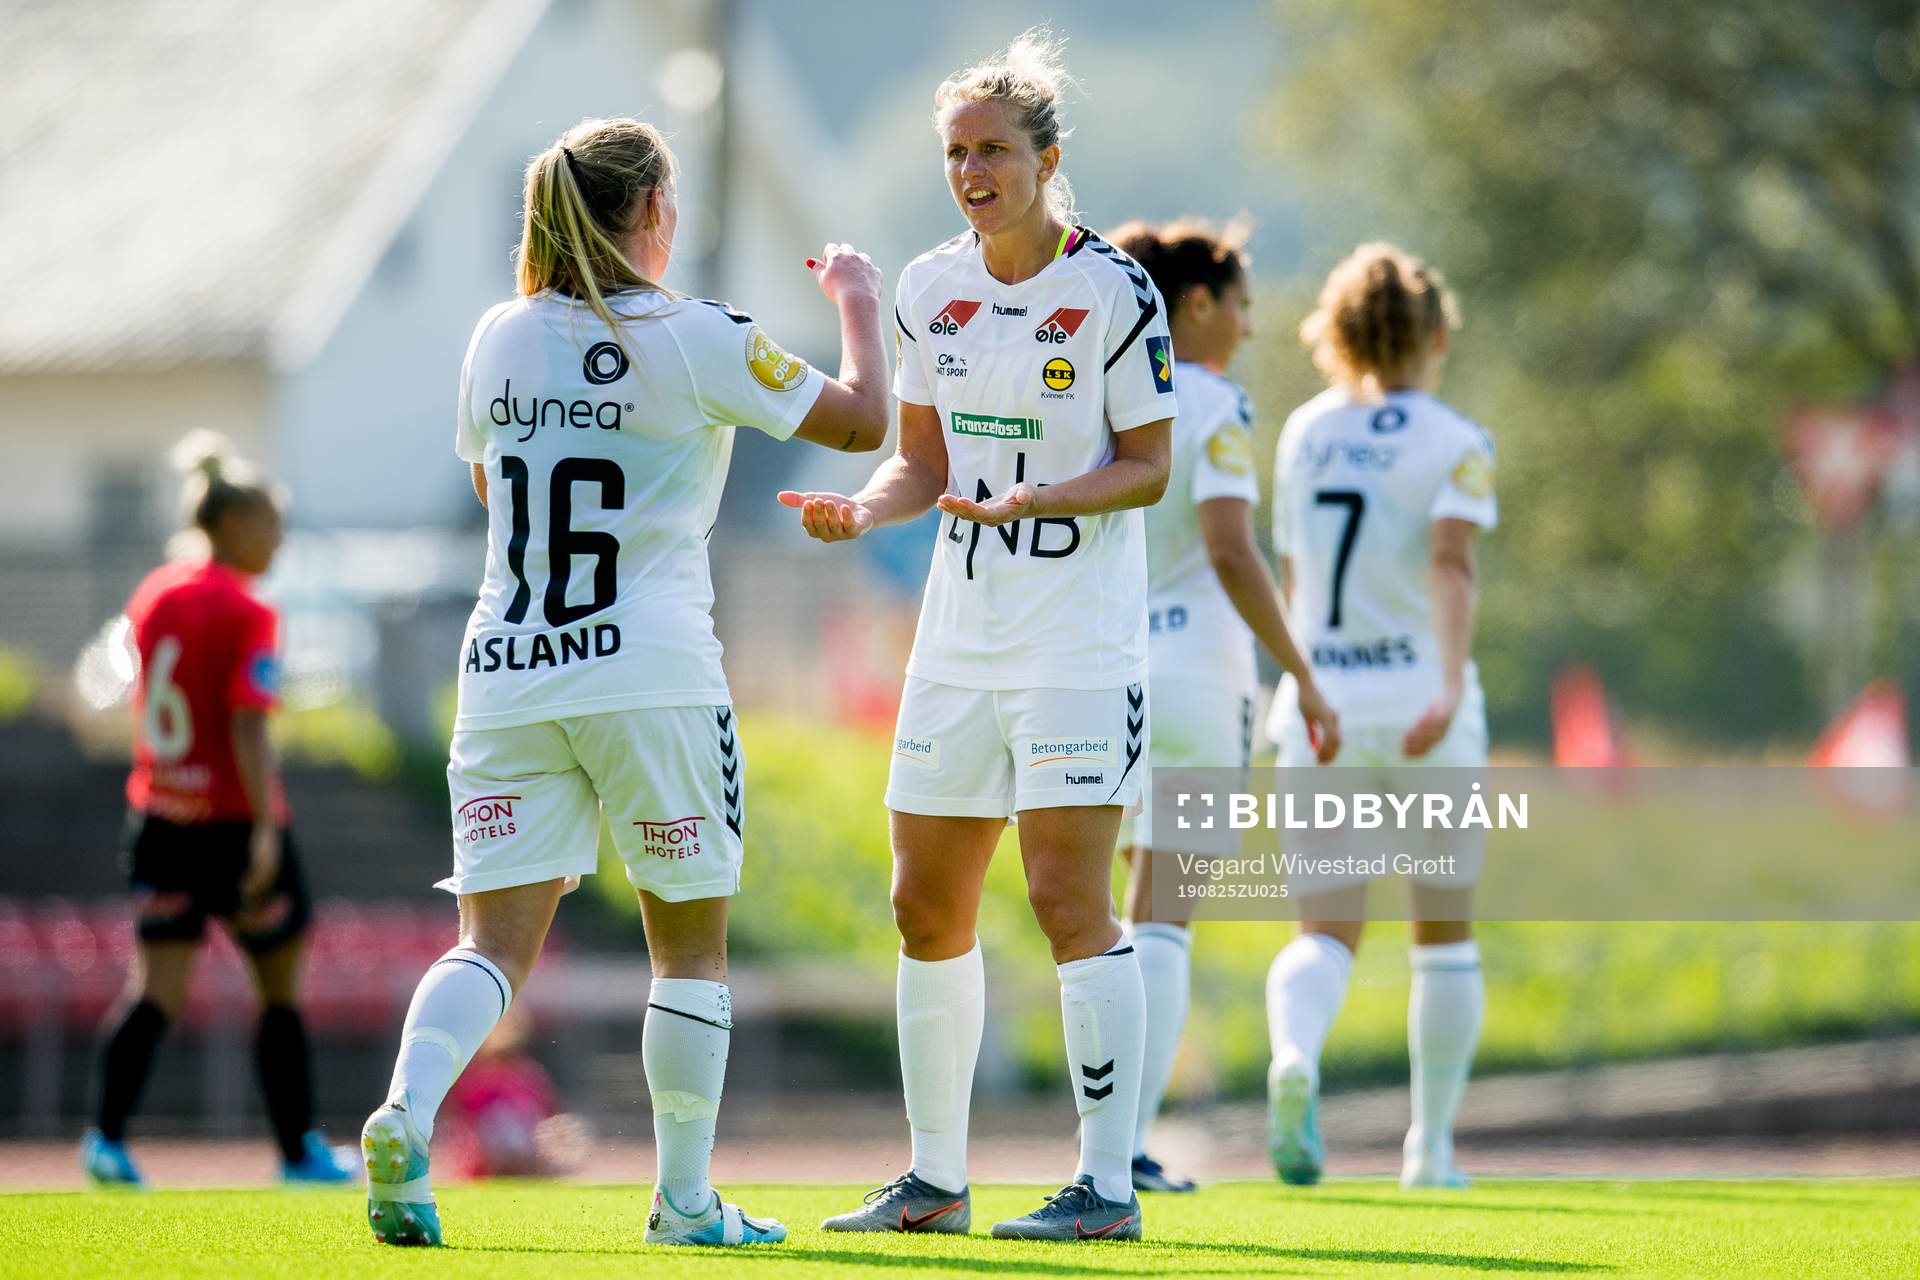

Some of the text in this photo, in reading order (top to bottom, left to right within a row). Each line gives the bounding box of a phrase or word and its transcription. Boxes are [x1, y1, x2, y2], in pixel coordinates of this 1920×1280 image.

[992, 302, 1028, 317] hummel
[946, 368, 968, 377] SPORT
[1046, 370, 1071, 379] LSK
[955, 415, 1022, 436] Franzefoss
[501, 455, 626, 628] 16
[1315, 490, 1366, 629] 7
[145, 634, 193, 763] 6
[896, 738, 932, 754] garbeid
[1031, 739, 1109, 755] Betongarbeid
[1065, 773, 1104, 785] hummel
[458, 796, 522, 827] THON
[464, 822, 517, 844] HOTELS
[633, 816, 706, 845] THON
[645, 843, 701, 860] HOTELS
